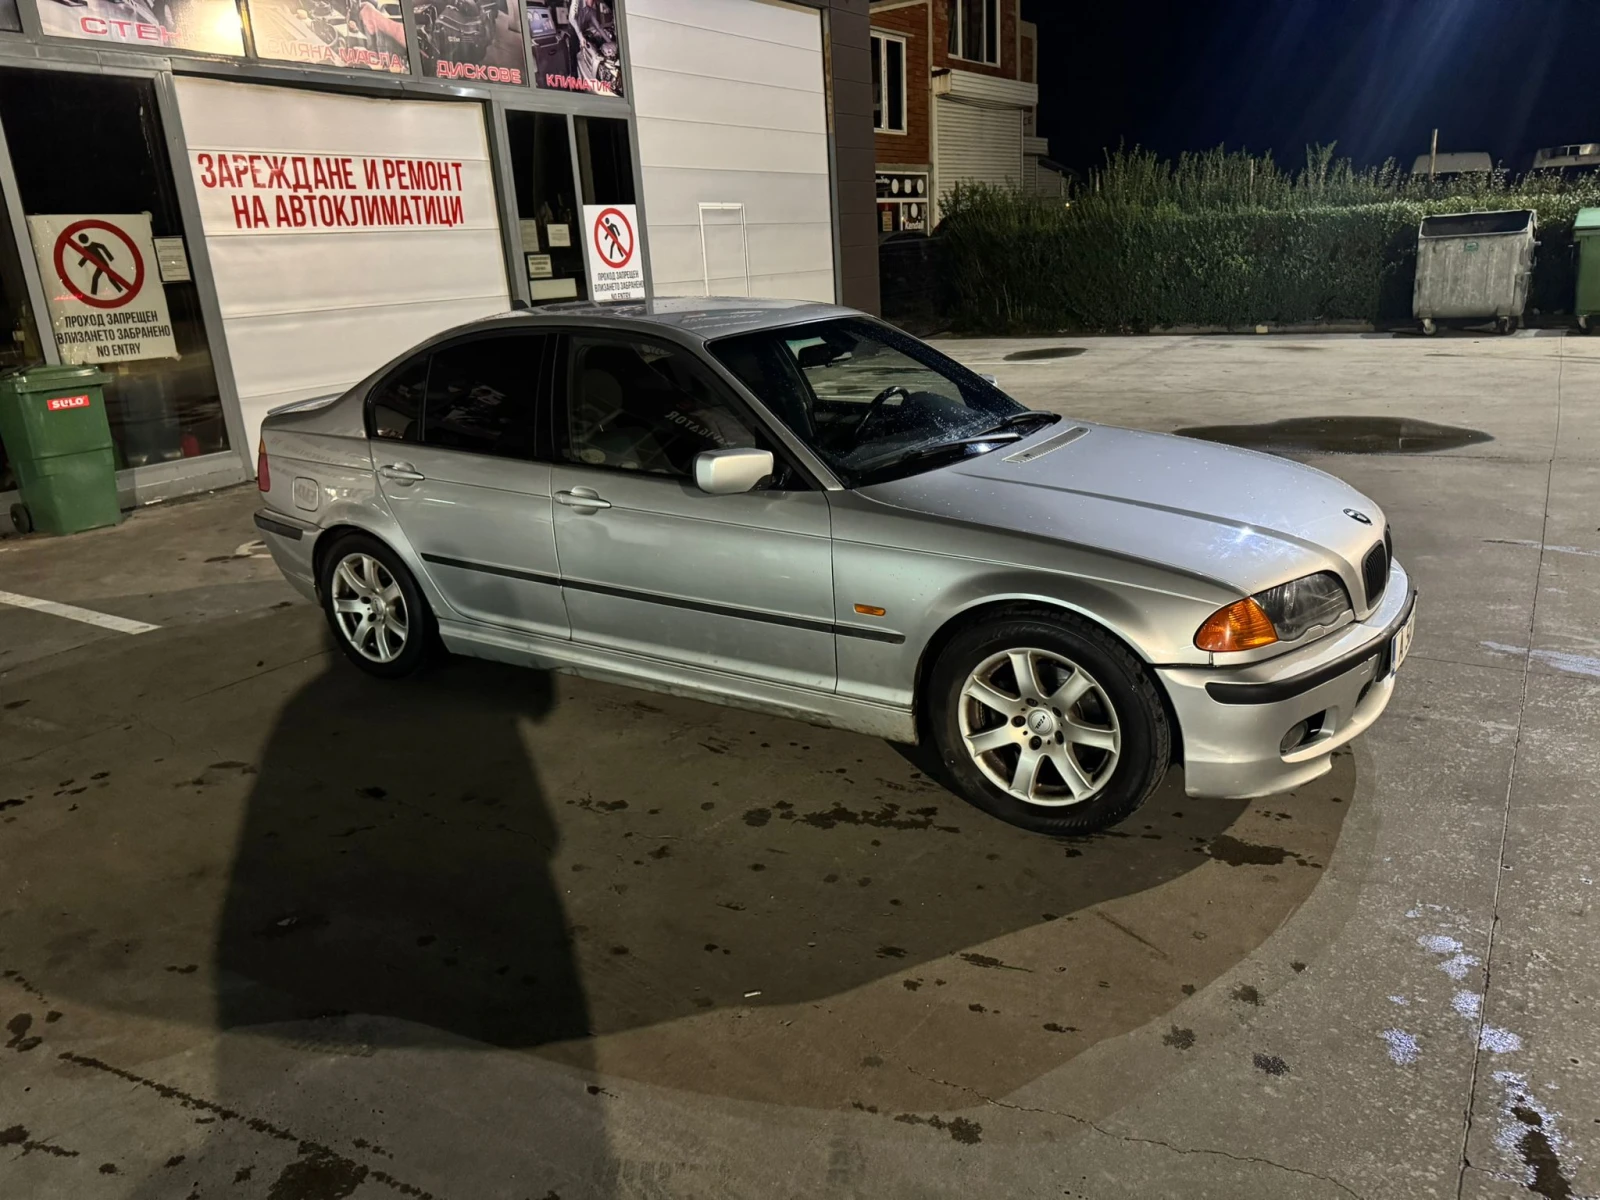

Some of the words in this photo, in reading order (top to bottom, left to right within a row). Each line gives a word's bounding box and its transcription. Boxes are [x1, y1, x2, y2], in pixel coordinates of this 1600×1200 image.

[436, 60, 522, 84] ДИСКОВЕ
[197, 153, 357, 193] ЗАРЕЖДАНЕ
[363, 158, 380, 190] И
[383, 159, 463, 191] РЕМОНТ
[231, 195, 270, 229] НА
[275, 195, 464, 227] АВТОКЛИМАТИЦИ
[64, 313, 106, 328] ПРОХОД
[106, 310, 158, 326] ЗАПРЕЩЕН
[56, 328, 116, 345] ВЛИЗАНЕТО
[116, 325, 171, 341] ЗАБРАНЕНО
[96, 344, 110, 357] NO
[112, 342, 141, 356] ENTRY
[52, 397, 84, 409] SULO
